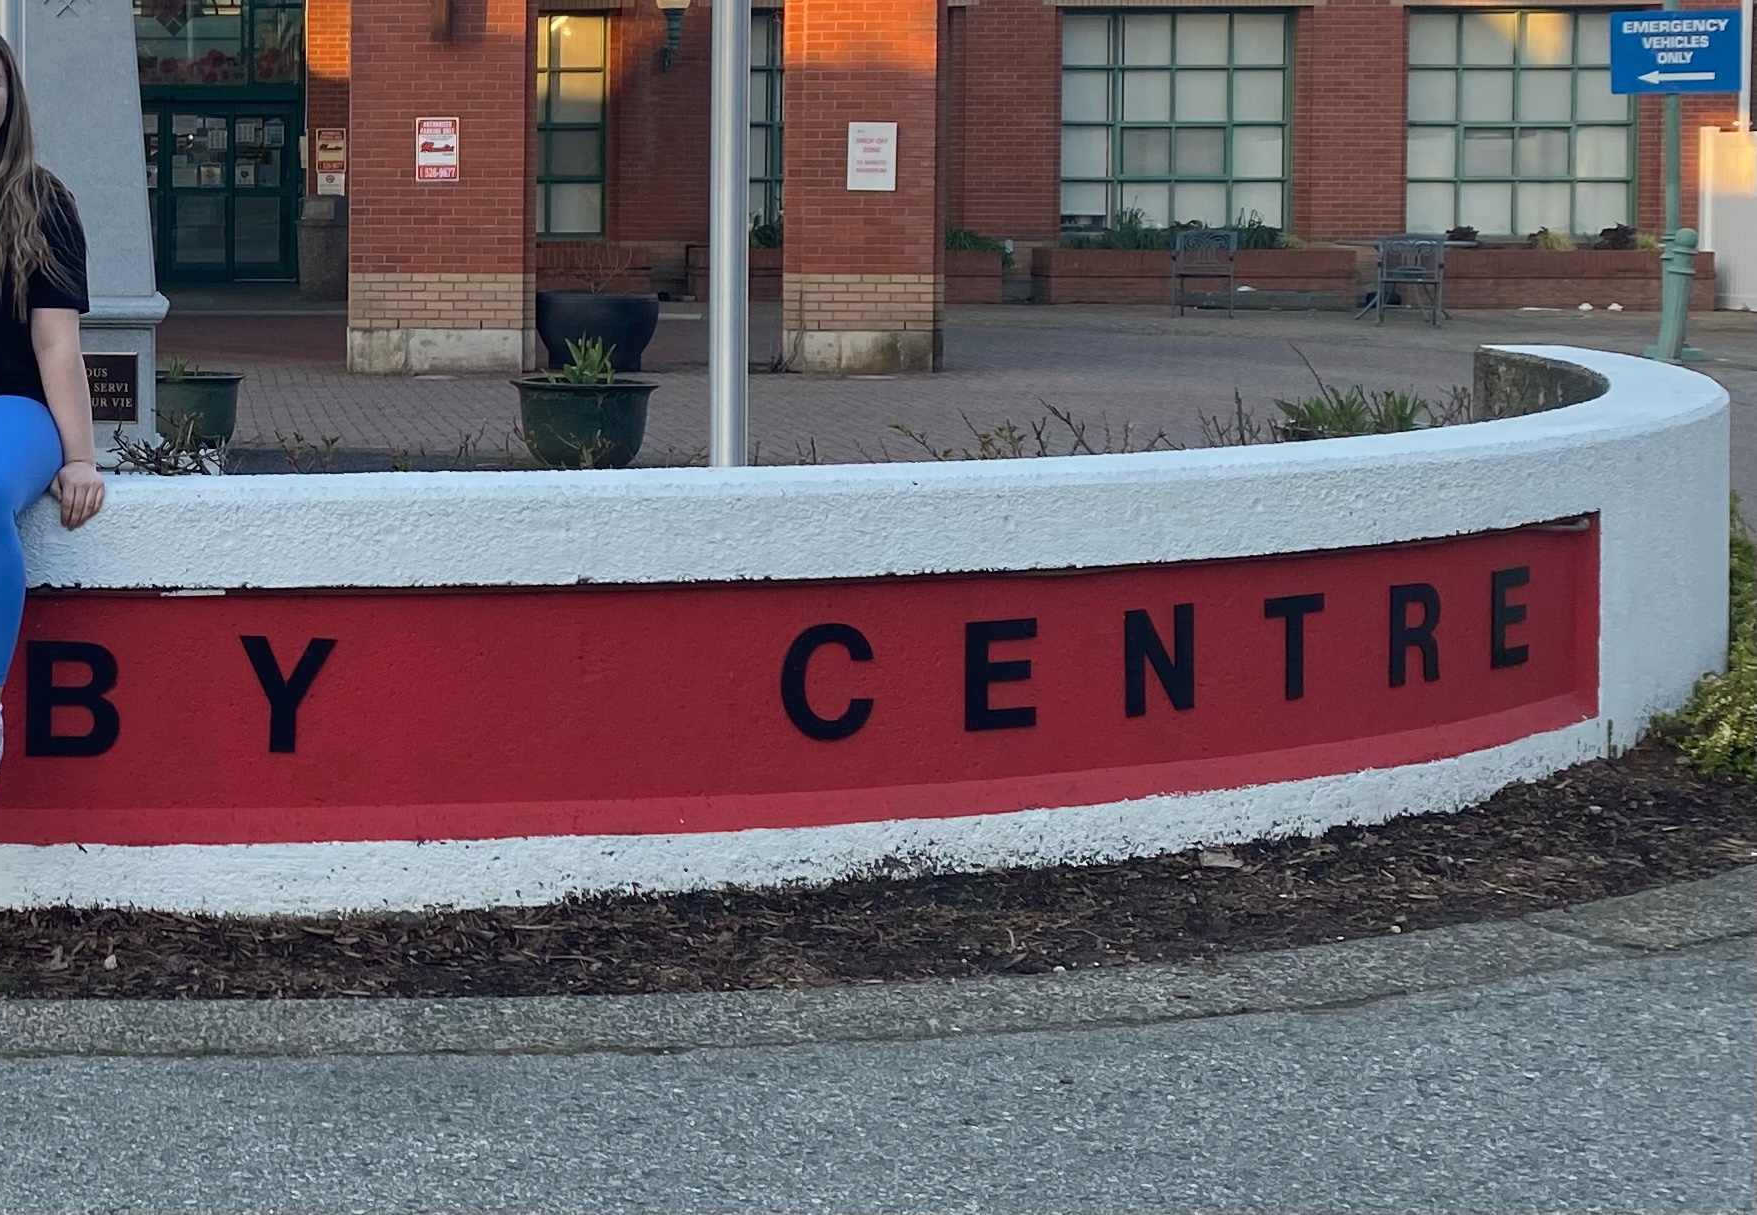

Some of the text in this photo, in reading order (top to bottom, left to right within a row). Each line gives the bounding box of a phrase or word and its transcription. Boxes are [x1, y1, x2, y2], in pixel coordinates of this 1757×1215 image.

[1622, 18, 1729, 34] EMERGENCY
[1642, 35, 1710, 49] VEHICLES
[1656, 51, 1694, 64] ONLY
[86, 367, 108, 377] OUS
[93, 382, 129, 393] SERVI
[112, 397, 133, 408] VIE
[780, 566, 1530, 742] CENTRE
